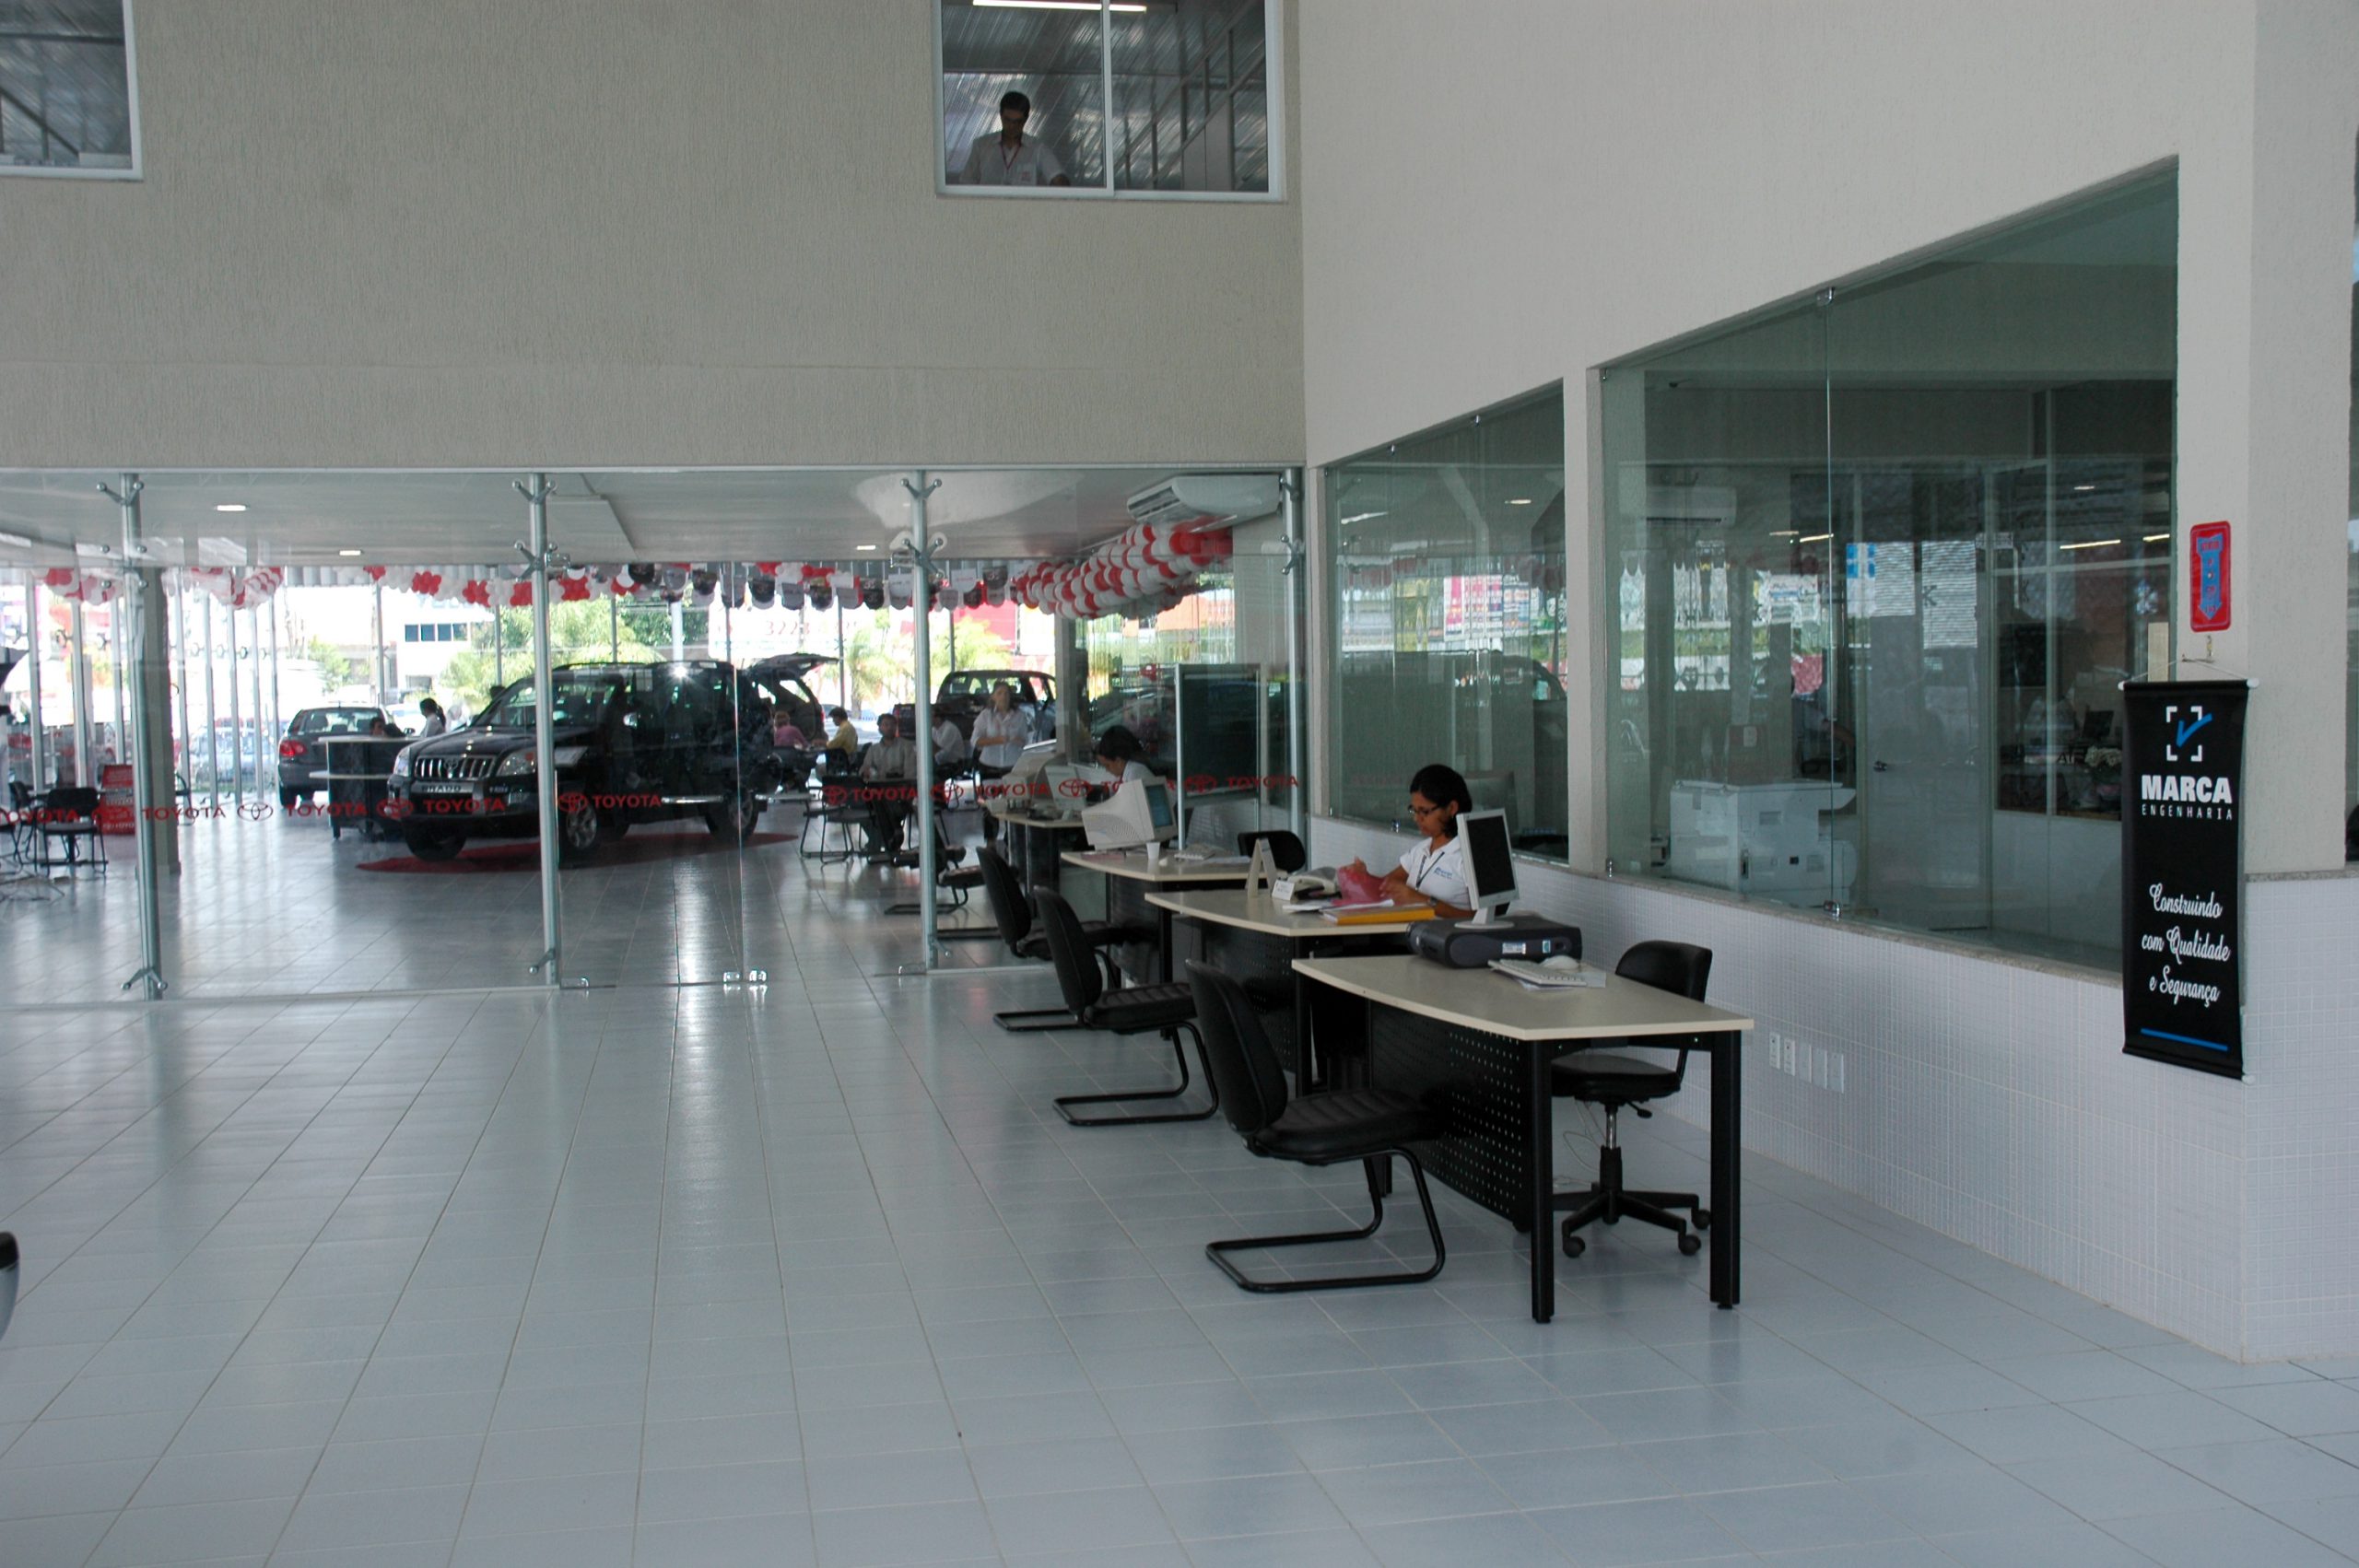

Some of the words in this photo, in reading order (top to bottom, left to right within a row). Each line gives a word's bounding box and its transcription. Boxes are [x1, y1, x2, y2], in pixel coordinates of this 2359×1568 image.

[1226, 775, 1298, 789] TOYOTA
[2141, 775, 2232, 804] MARCA
[593, 793, 662, 809] TOYOTA
[852, 786, 918, 802] TOYOTA
[142, 806, 227, 822] TOYOTA
[287, 802, 368, 818] TOYOTA
[423, 797, 506, 814] TOYOTA
[2141, 803, 2233, 821] ENGENHARIA
[2149, 883, 2223, 919] Construindo
[2141, 932, 2165, 953] com
[2166, 925, 2231, 965] Qualidade
[2149, 973, 2157, 992] e
[2160, 965, 2221, 1008] Segurança
